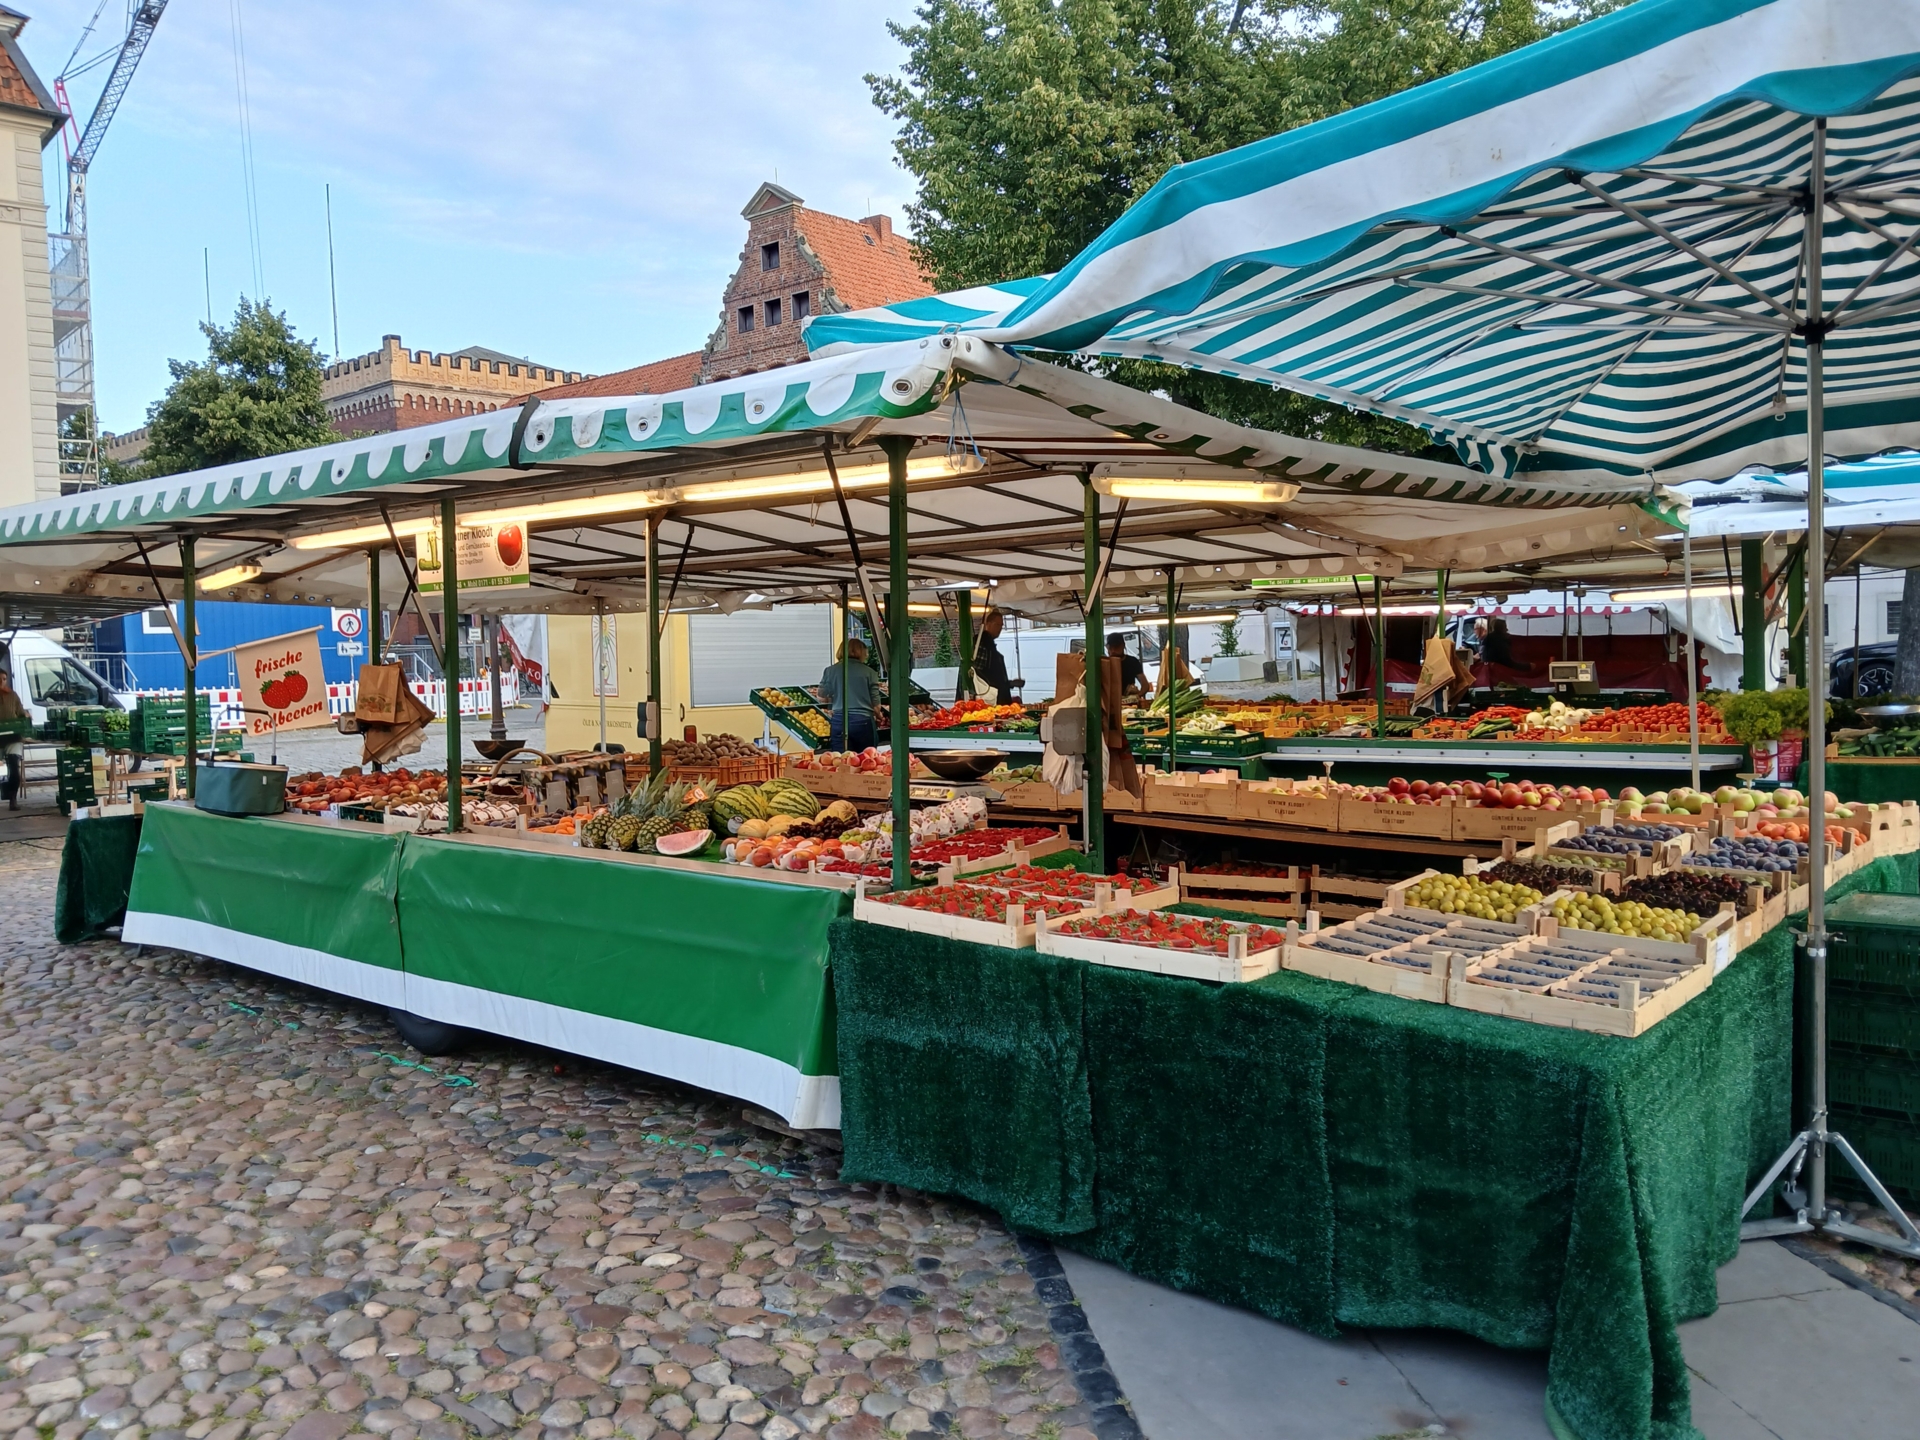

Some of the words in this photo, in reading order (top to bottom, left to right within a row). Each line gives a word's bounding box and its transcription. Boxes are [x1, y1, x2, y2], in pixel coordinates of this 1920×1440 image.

[472, 526, 494, 540] Kloodt
[478, 578, 488, 587] 0171
[492, 578, 497, 586] 61
[254, 650, 303, 679] frische
[253, 700, 323, 734] Erdbeeren
